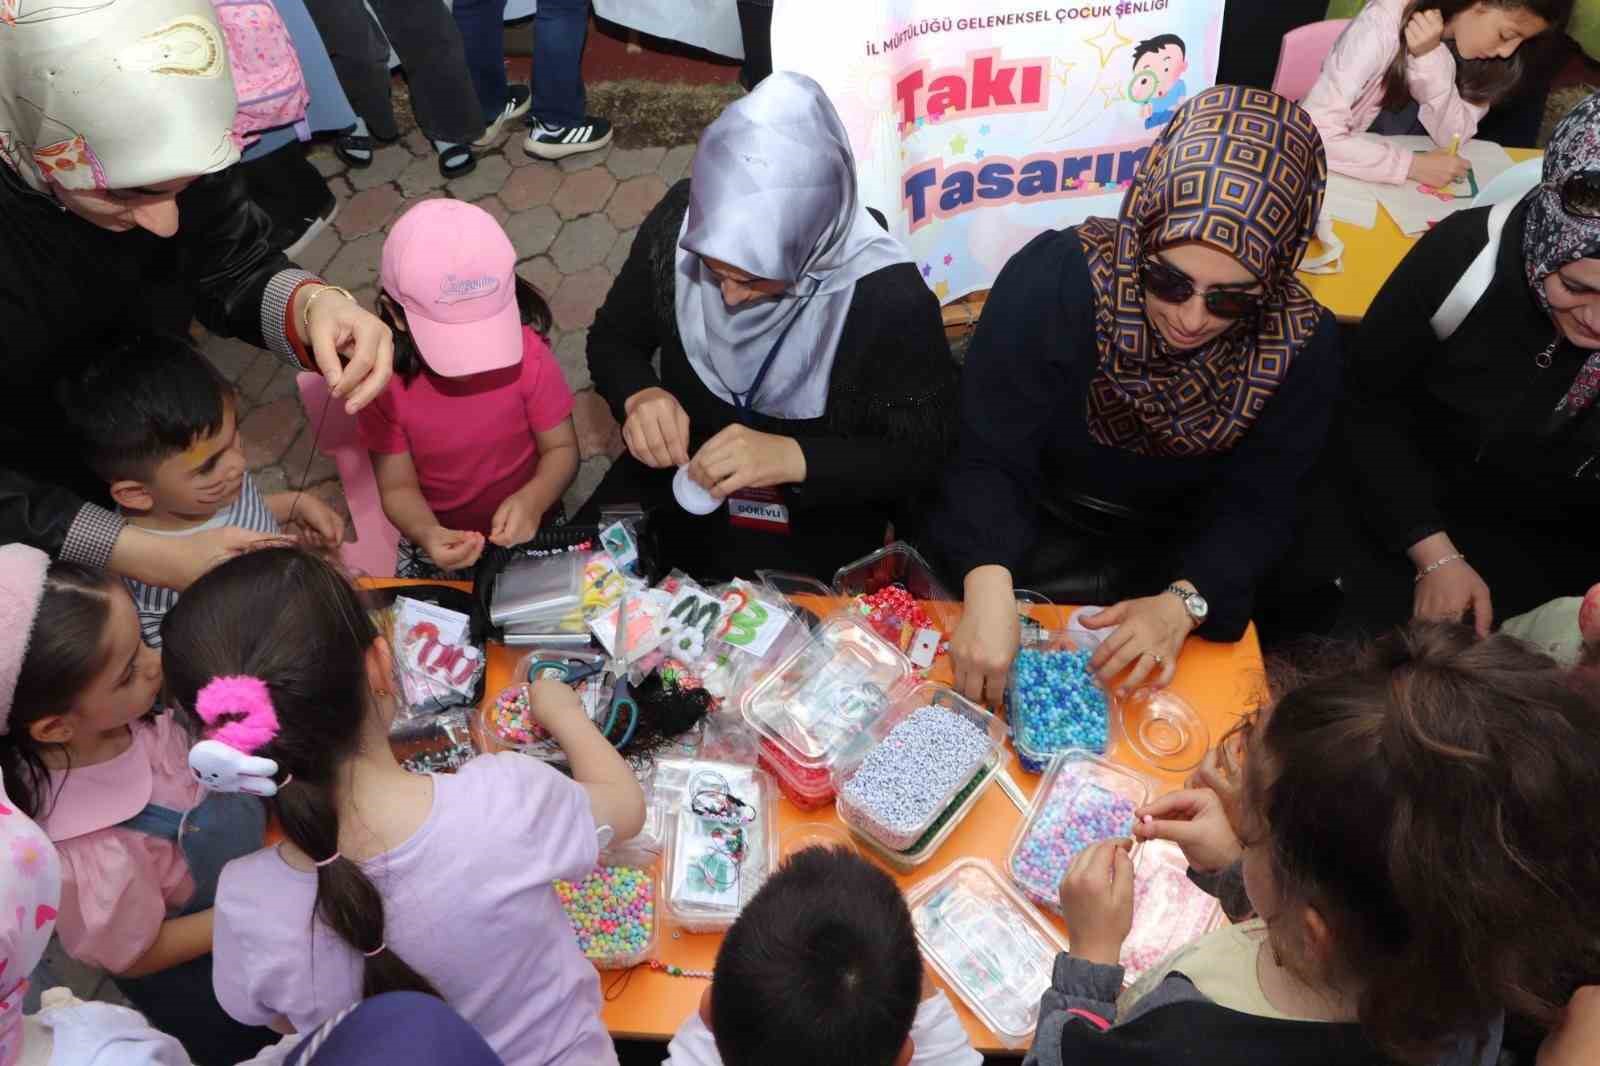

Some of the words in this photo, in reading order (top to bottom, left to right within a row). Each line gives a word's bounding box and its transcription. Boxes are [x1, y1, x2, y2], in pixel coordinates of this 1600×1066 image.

[866, 41, 880, 56] İL
[956, 9, 1052, 31] GELENEKSEL
[1055, 5, 1112, 24] ÇOCUK
[896, 56, 1043, 125] Takı
